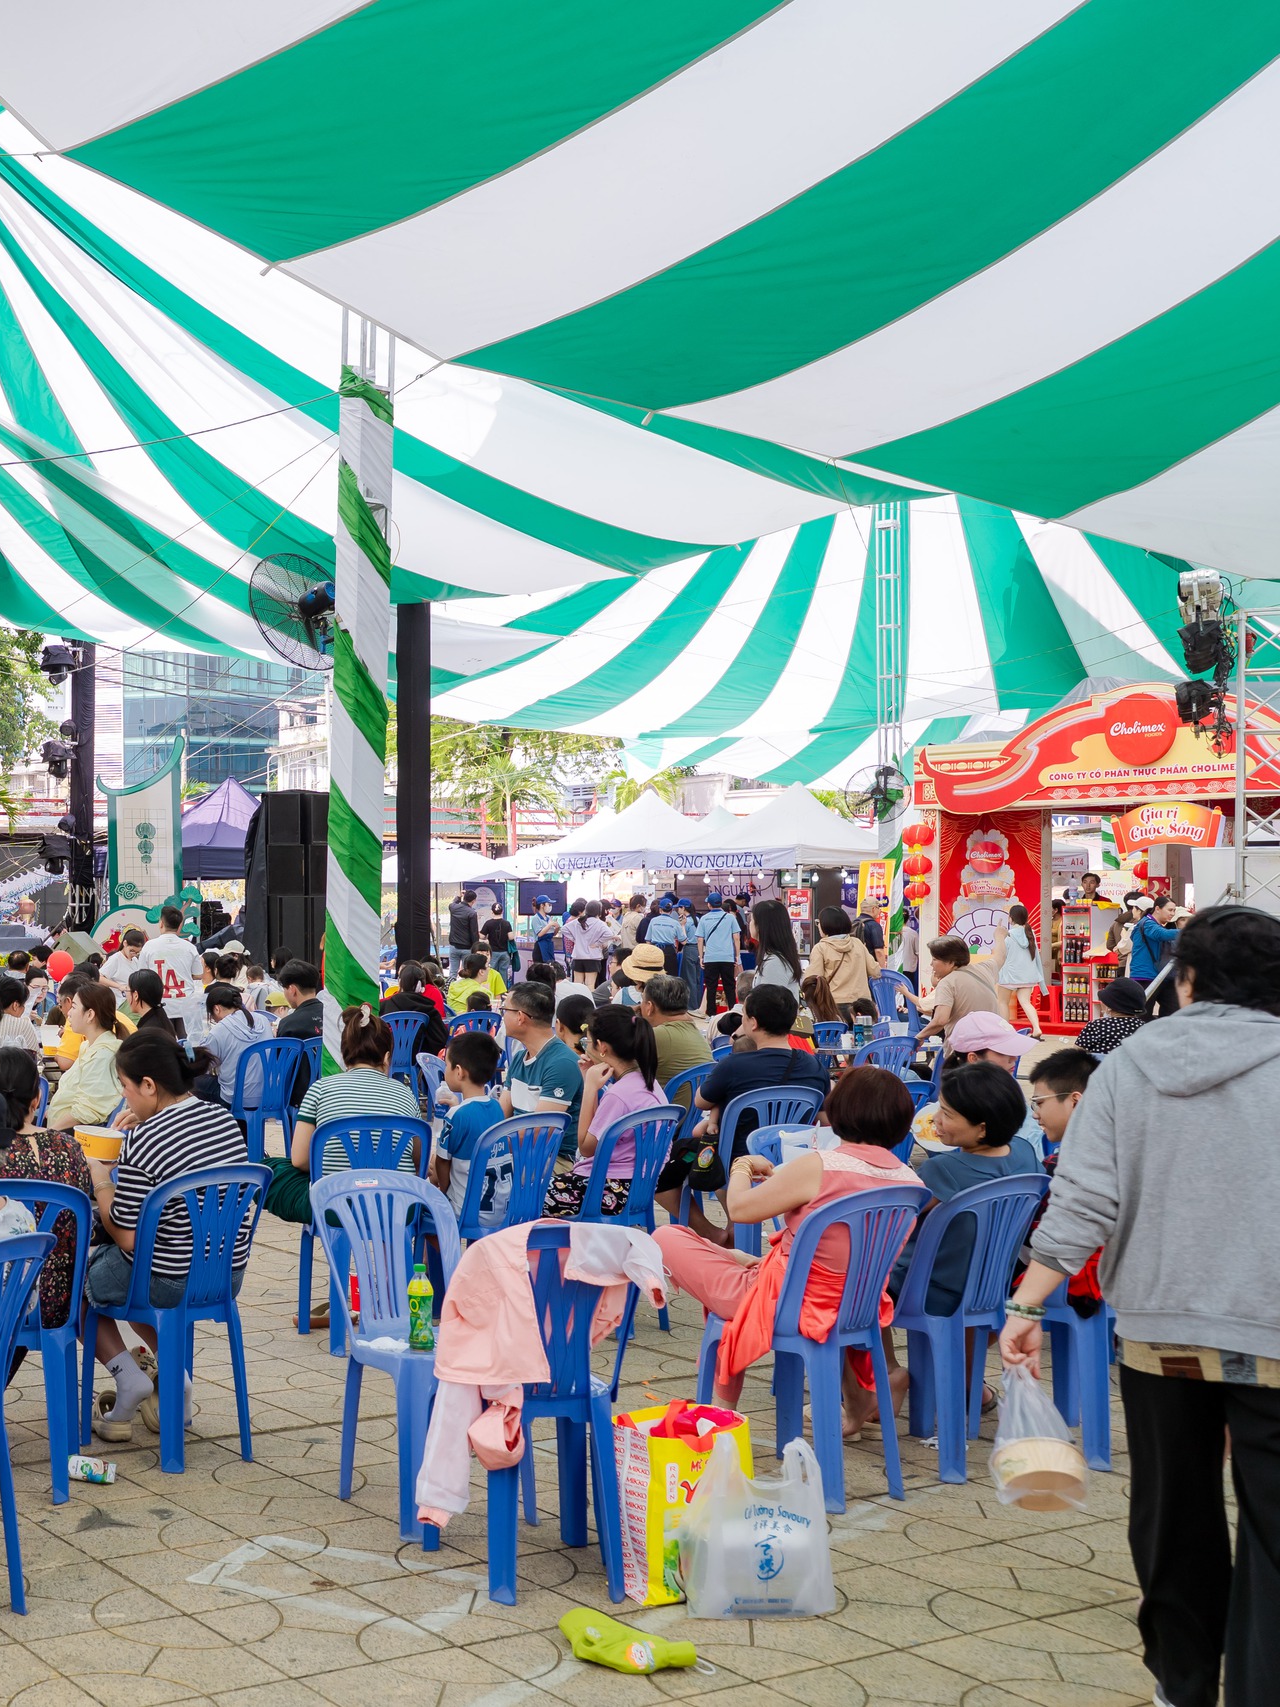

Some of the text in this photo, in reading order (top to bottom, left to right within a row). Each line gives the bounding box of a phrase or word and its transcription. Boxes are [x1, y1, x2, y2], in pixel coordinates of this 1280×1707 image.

[1110, 720, 1166, 738] Cholimex
[1049, 763, 1236, 781] CÔNG TY CỔ PHẦN THỰC PHẨM CHOLIME
[1140, 807, 1179, 824] Gia vị
[1129, 820, 1206, 842] Cuộc Sống
[154, 960, 186, 998] LA
[778, 1505, 811, 1528] Savoury
